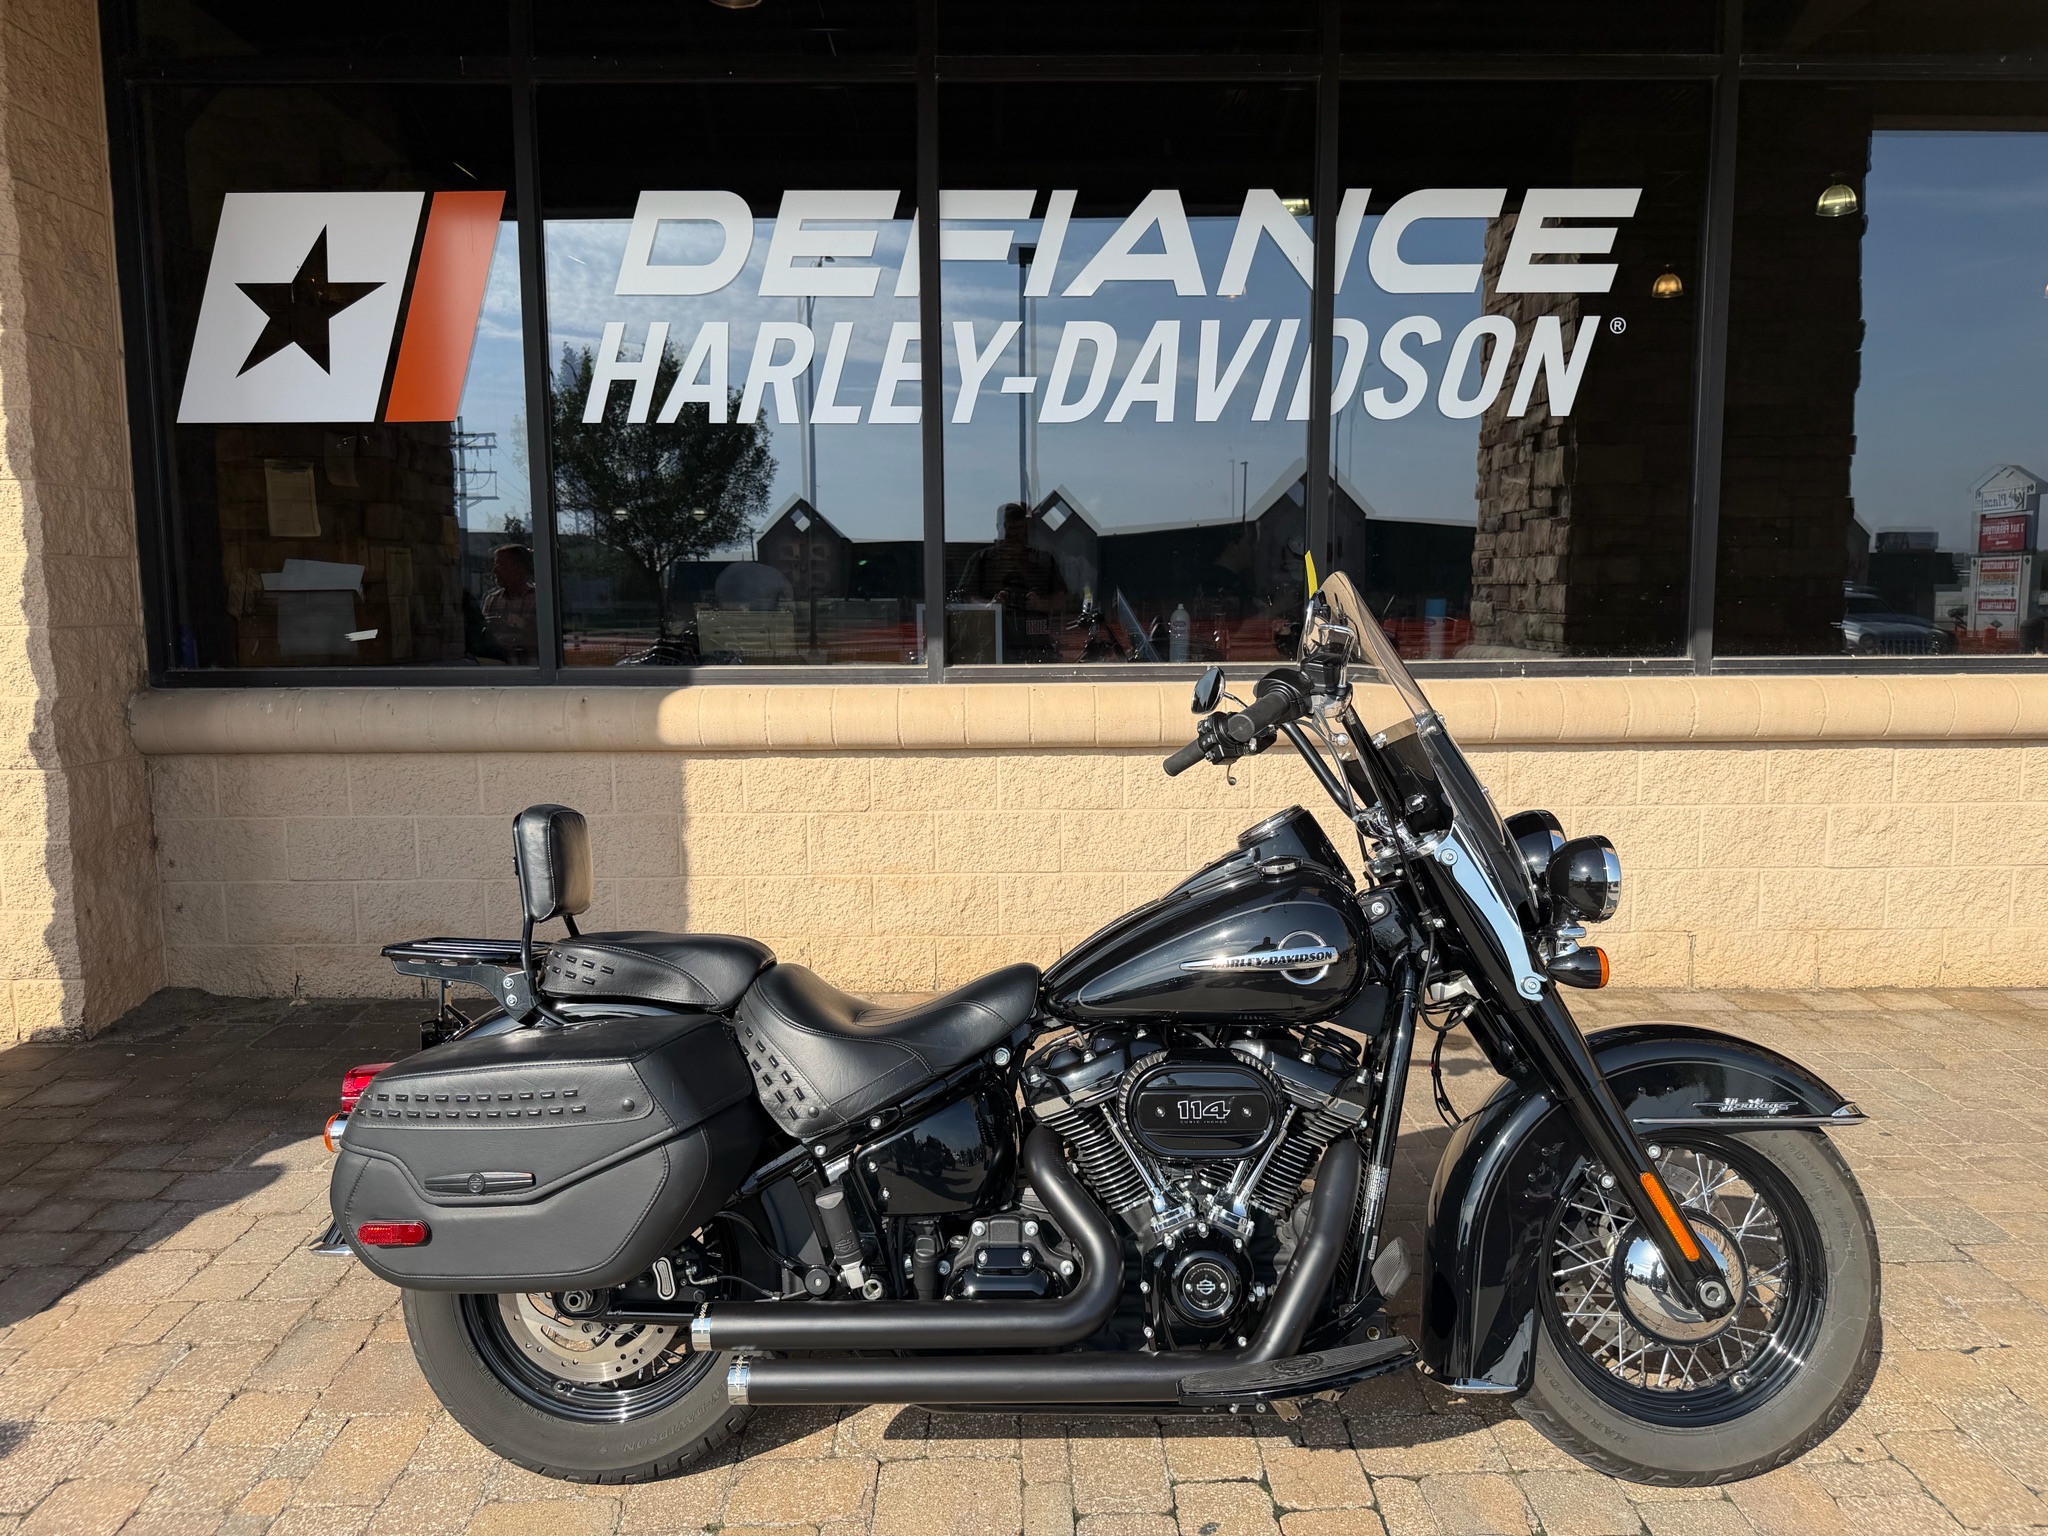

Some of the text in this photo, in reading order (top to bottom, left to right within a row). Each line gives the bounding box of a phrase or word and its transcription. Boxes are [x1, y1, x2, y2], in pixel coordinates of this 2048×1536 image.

[614, 188, 1643, 297] DEFIANCE
[581, 315, 1601, 425] HARLEY-DAVIDSON
[1177, 1100, 1231, 1120] 114
